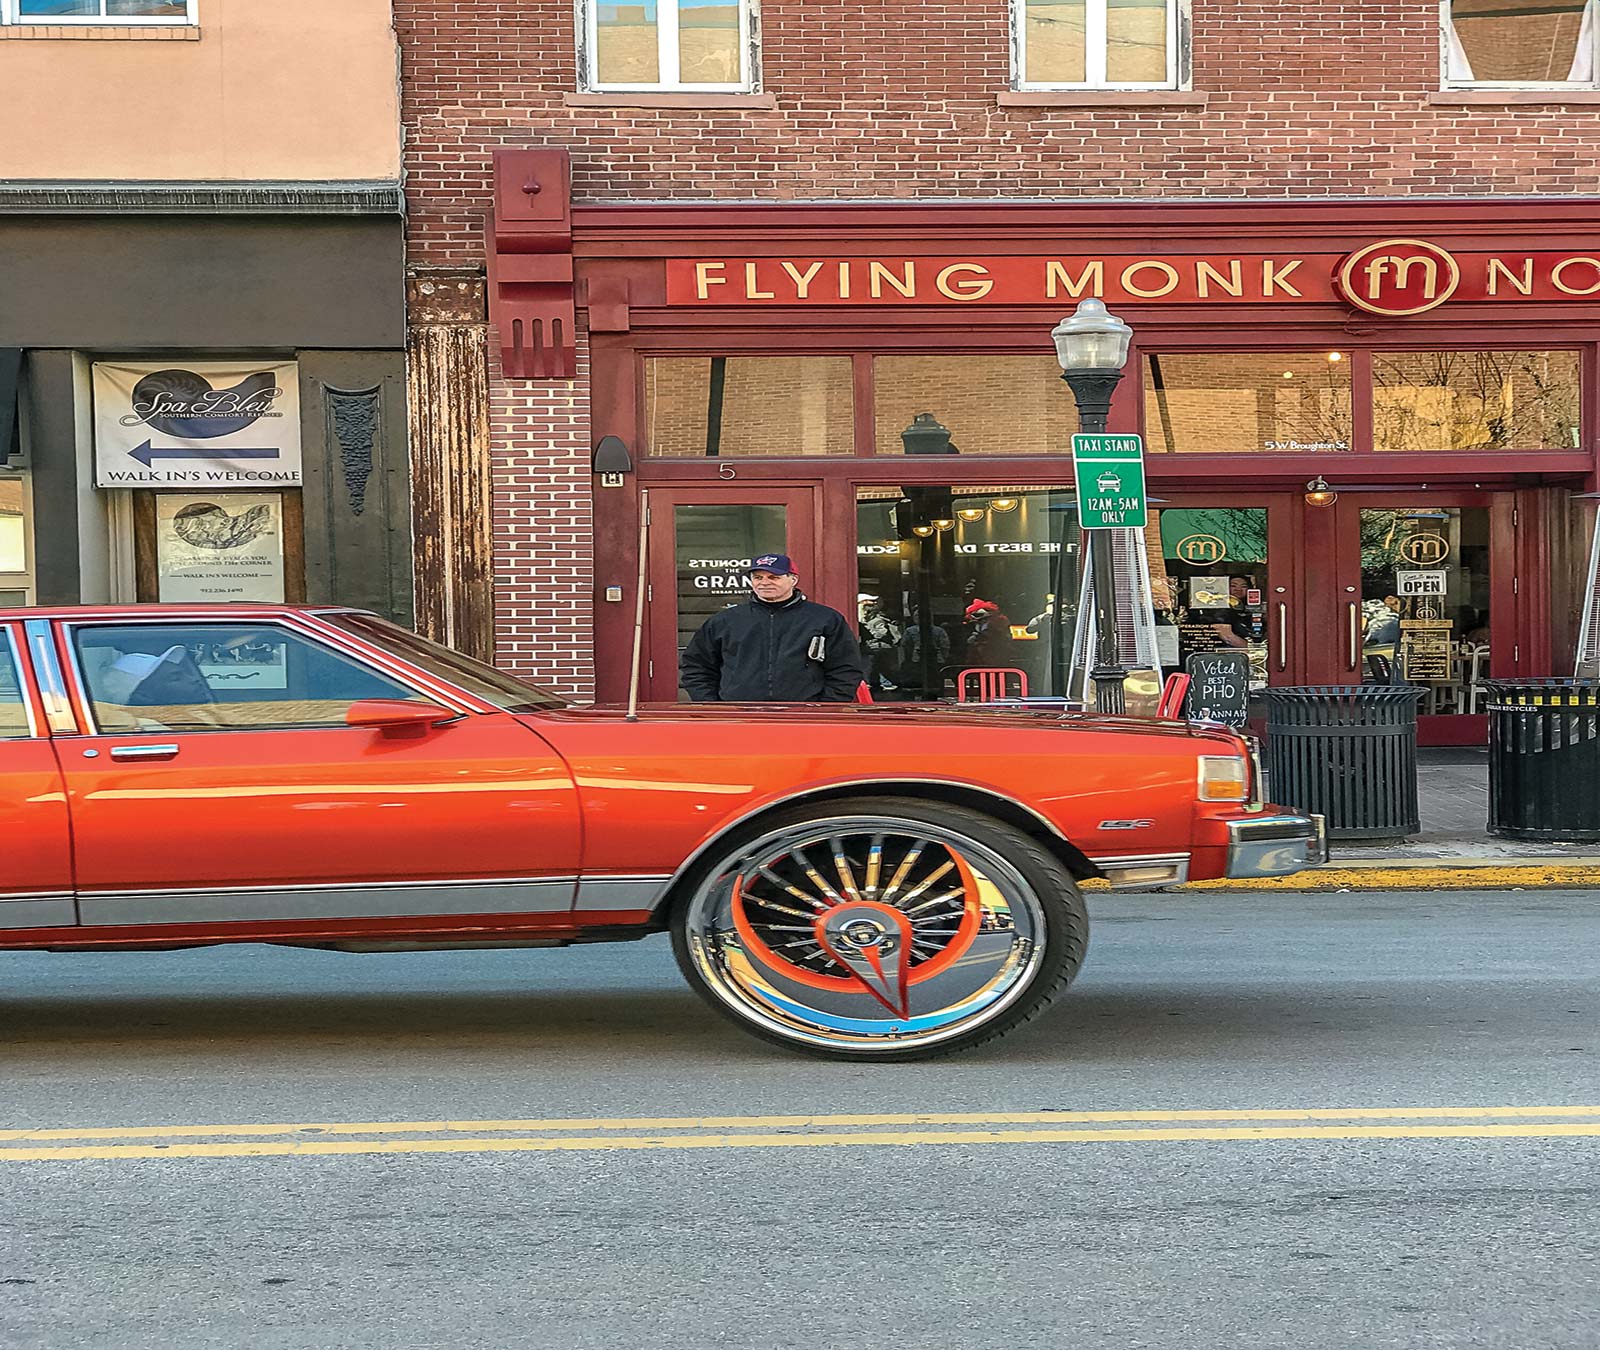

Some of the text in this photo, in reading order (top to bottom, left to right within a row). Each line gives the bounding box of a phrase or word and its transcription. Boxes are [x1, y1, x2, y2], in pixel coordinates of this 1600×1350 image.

[695, 260, 1303, 301] FLYING MONK
[1364, 256, 1437, 299] fm
[1488, 257, 1600, 295] NO
[119, 387, 283, 427] Spa Bleu
[1078, 439, 1137, 452] TAXI STAND
[1264, 441, 1275, 450] 5
[1275, 441, 1289, 450] W
[1290, 440, 1335, 452] Broughton
[107, 470, 300, 481] WALK IN'S WELCOME
[719, 463, 736, 480] 5
[1101, 511, 1126, 523] ONLY
[1403, 581, 1441, 593] OPEN
[1200, 659, 1238, 675] Voted
[1202, 684, 1235, 700] PHO
[1191, 709, 1246, 719] SAANNAH
